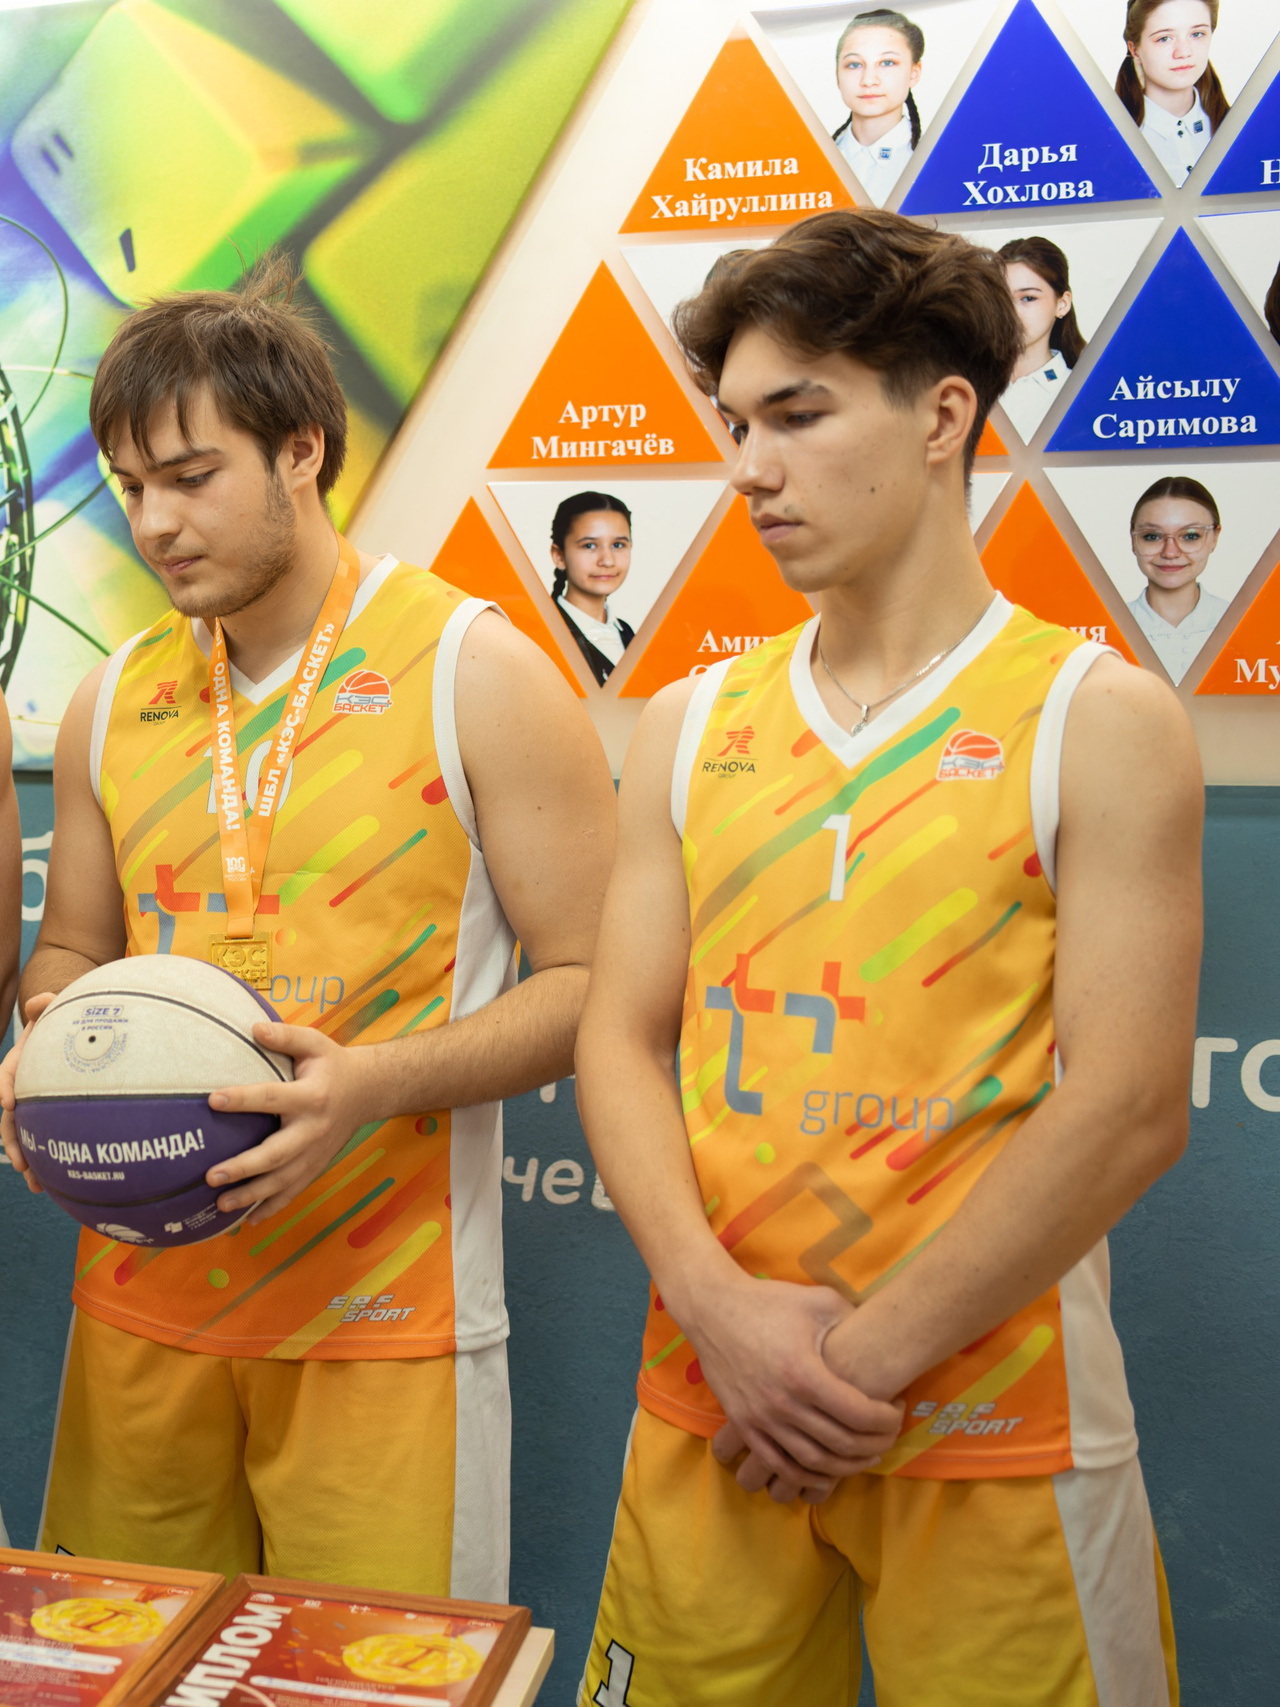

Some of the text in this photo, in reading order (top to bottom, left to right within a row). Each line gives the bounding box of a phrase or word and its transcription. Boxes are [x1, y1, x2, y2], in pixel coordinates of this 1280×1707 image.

[683, 157, 799, 182] Камила
[977, 143, 1078, 174] Дарья
[650, 190, 834, 222] Хайруллина
[962, 180, 1095, 206] Хохлова
[1108, 375, 1241, 403] Айсылу
[558, 400, 647, 429] Артур
[1092, 413, 1258, 444] Саримова
[531, 433, 675, 459] Мингачёв
[213, 662, 228, 718] ОДНА
[140, 710, 179, 722] RENOVA
[333, 703, 386, 713] БАСКЕТ
[217, 721, 241, 830] КОМАНДА!
[702, 761, 756, 773] RENOVA
[258, 769, 282, 817] ШБЛ
[820, 814, 852, 901] 1
[113, 1007, 120, 1016] 7
[800, 1090, 955, 1143] group
[20, 1126, 37, 1152] МЫ
[47, 1138, 94, 1165] ОДНА
[96, 1128, 205, 1165] КОМАНДА!
[67, 1169, 125, 1181] KES-BASKET.RU
[340, 1306, 417, 1323] SPORT
[927, 1416, 1024, 1435] SPORT
[160, 1602, 292, 1707] ИПЛОМ
